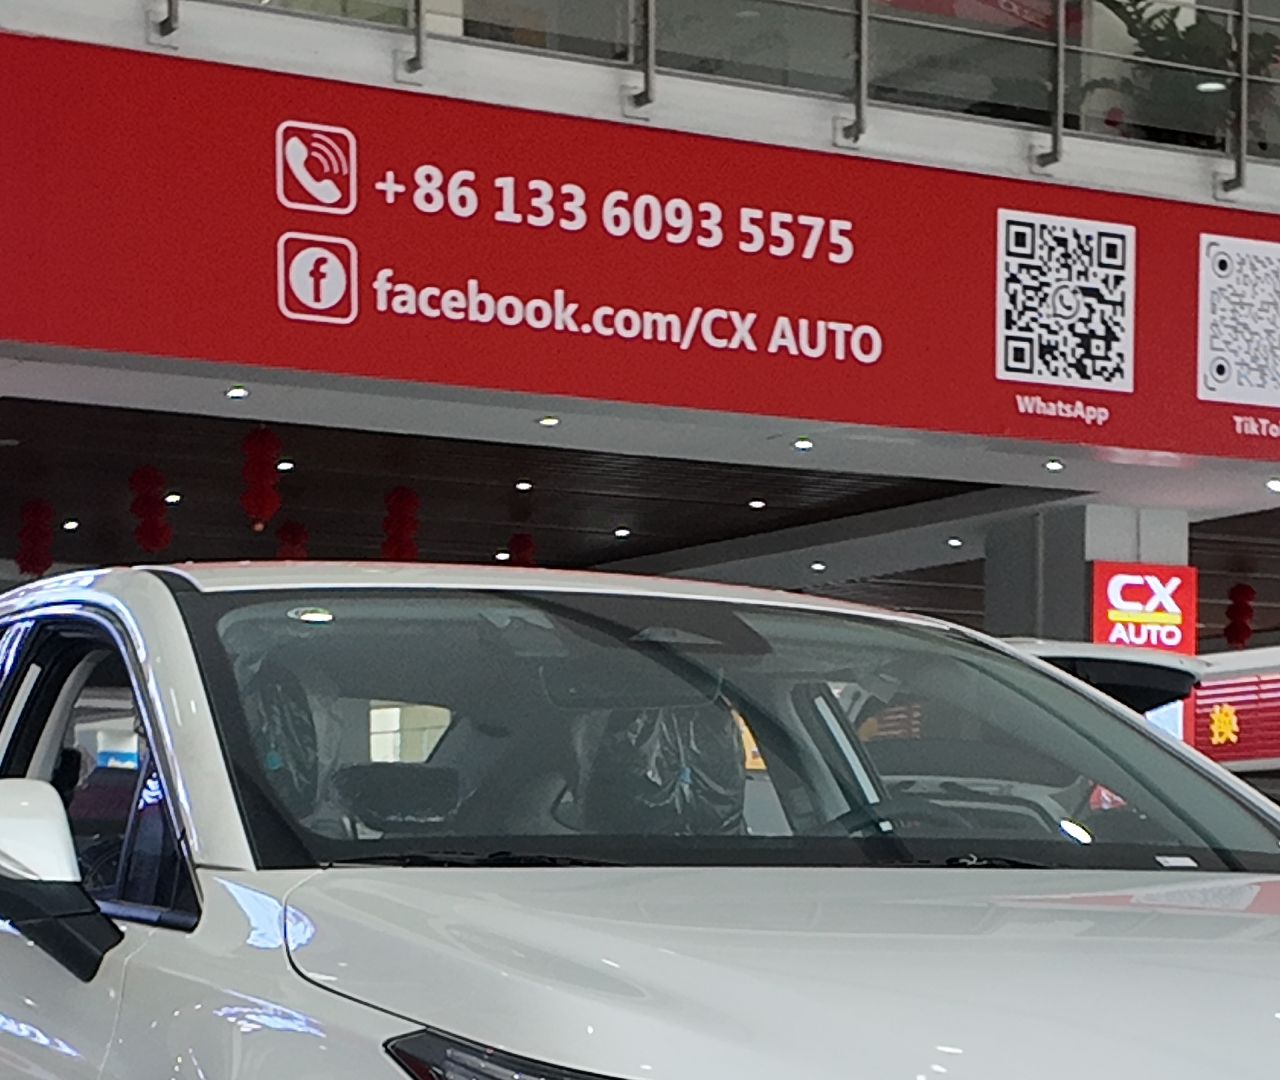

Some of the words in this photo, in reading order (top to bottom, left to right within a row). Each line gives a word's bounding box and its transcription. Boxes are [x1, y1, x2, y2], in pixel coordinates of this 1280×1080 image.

[375, 165, 477, 217] +86
[494, 176, 587, 231] 133
[602, 190, 723, 248] 6093
[738, 208, 854, 264] 5575
[373, 268, 757, 351] facebook.com/CX
[767, 317, 882, 364] AUTO
[1016, 394, 1110, 425] WhatsApp
[1107, 573, 1182, 613] CX
[1108, 623, 1182, 648] AUTO
